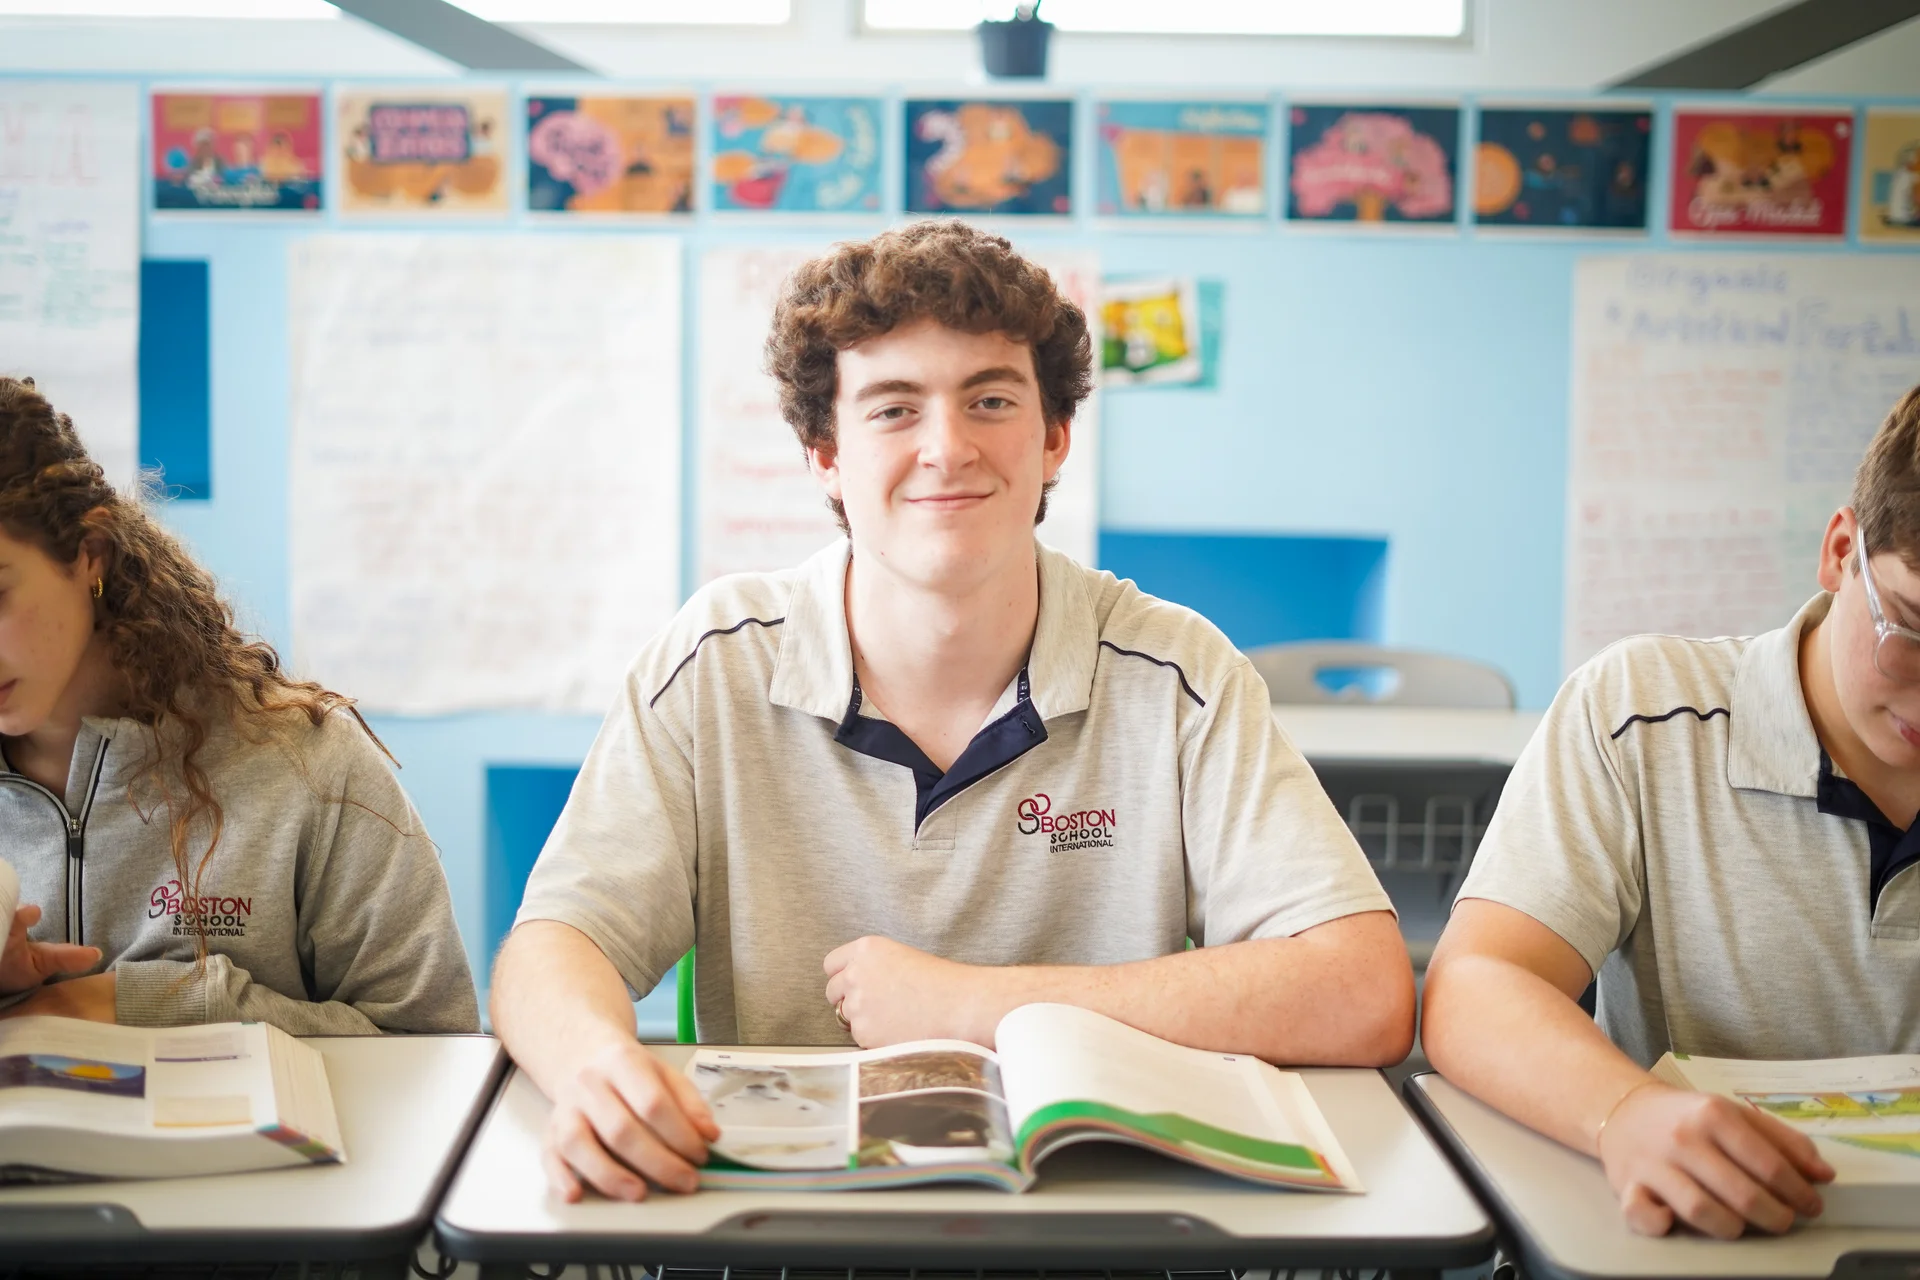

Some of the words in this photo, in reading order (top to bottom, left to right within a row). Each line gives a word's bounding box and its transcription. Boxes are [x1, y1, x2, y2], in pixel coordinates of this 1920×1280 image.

[1041, 809, 1116, 833] BOSTON
[1050, 827, 1112, 844] SCHOOL
[1050, 840, 1113, 853] INTERNATIONAL
[166, 897, 252, 915] BOSTON
